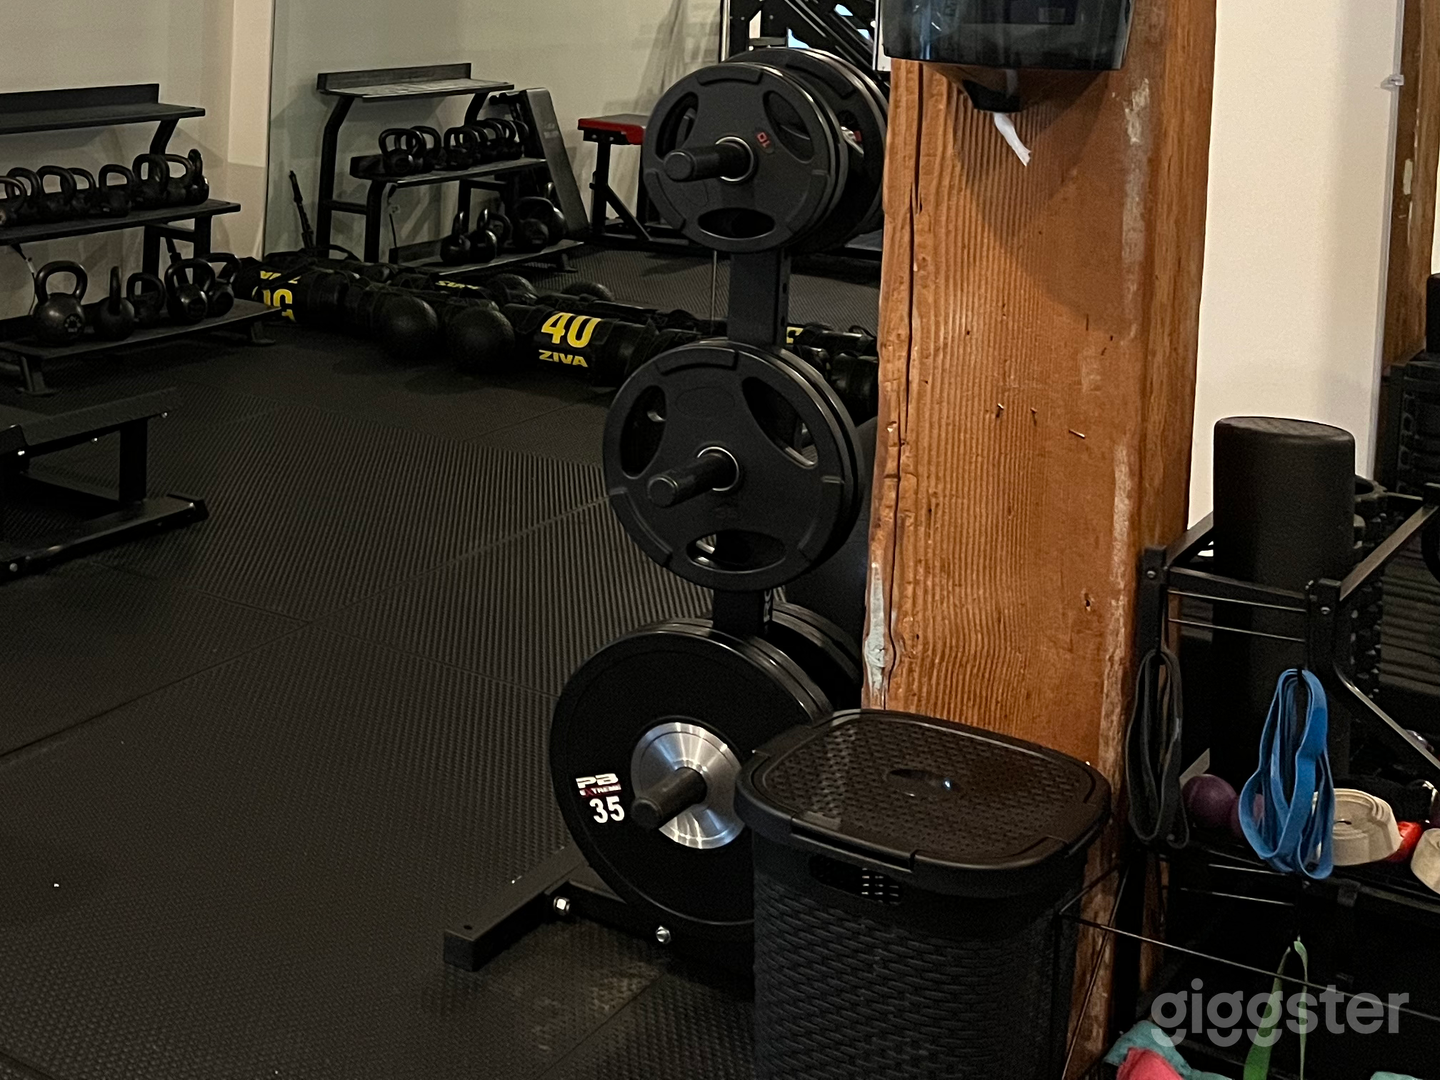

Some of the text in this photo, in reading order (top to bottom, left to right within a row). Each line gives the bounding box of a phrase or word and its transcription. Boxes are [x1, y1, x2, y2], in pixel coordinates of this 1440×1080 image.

[541, 312, 601, 348] 40
[538, 349, 589, 368] ZIVA
[589, 795, 625, 824] 35
